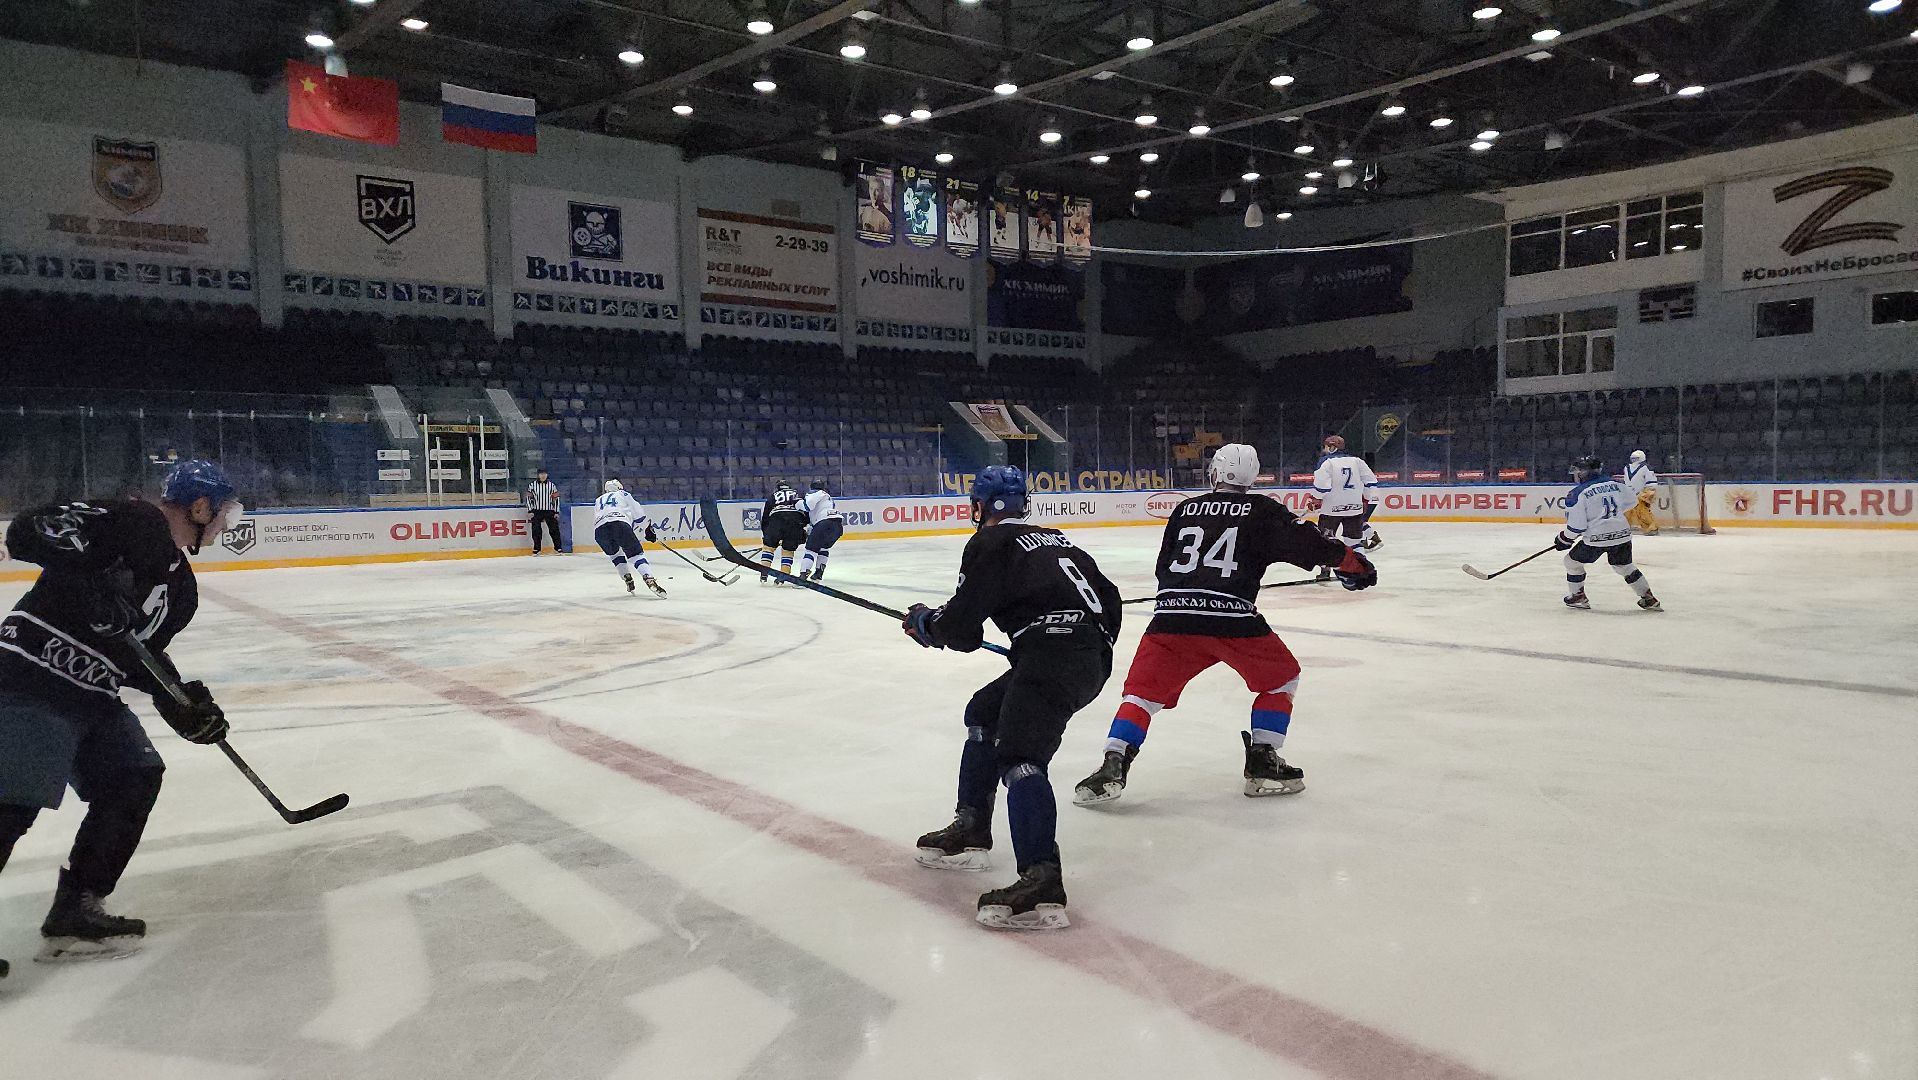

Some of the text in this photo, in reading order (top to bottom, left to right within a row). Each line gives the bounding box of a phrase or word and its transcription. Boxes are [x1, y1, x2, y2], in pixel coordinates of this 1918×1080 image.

[901, 165, 916, 178] 18
[946, 177, 960, 190] 21
[1026, 189, 1039, 201] 14
[361, 195, 413, 220] ВХЛ
[706, 226, 829, 253] R&T 2-29-39
[526, 256, 665, 290] Викинги
[707, 260, 769, 278] ВСЕ ВИДЫ
[869, 263, 965, 291] voshimik.ru
[707, 275, 830, 296] РЕКЛАМНЫХ УСЛУГ
[943, 469, 1170, 495] ЧЕОН СТРАНЫ
[1341, 467, 1354, 489] 2
[600, 493, 618, 510] 14
[1036, 501, 1096, 517] VHLRU.RU
[1147, 501, 1180, 511] SINT
[1384, 493, 1527, 510] OLIMPBET
[1772, 489, 1913, 517] FHR.RU
[883, 505, 971, 523] OLIMPB
[222, 527, 254, 546] ВХЛ
[264, 535, 294, 543] КУБОК
[390, 518, 533, 541] OLIMPBE
[1169, 525, 1239, 578] 34
[1058, 557, 1103, 614] 8
